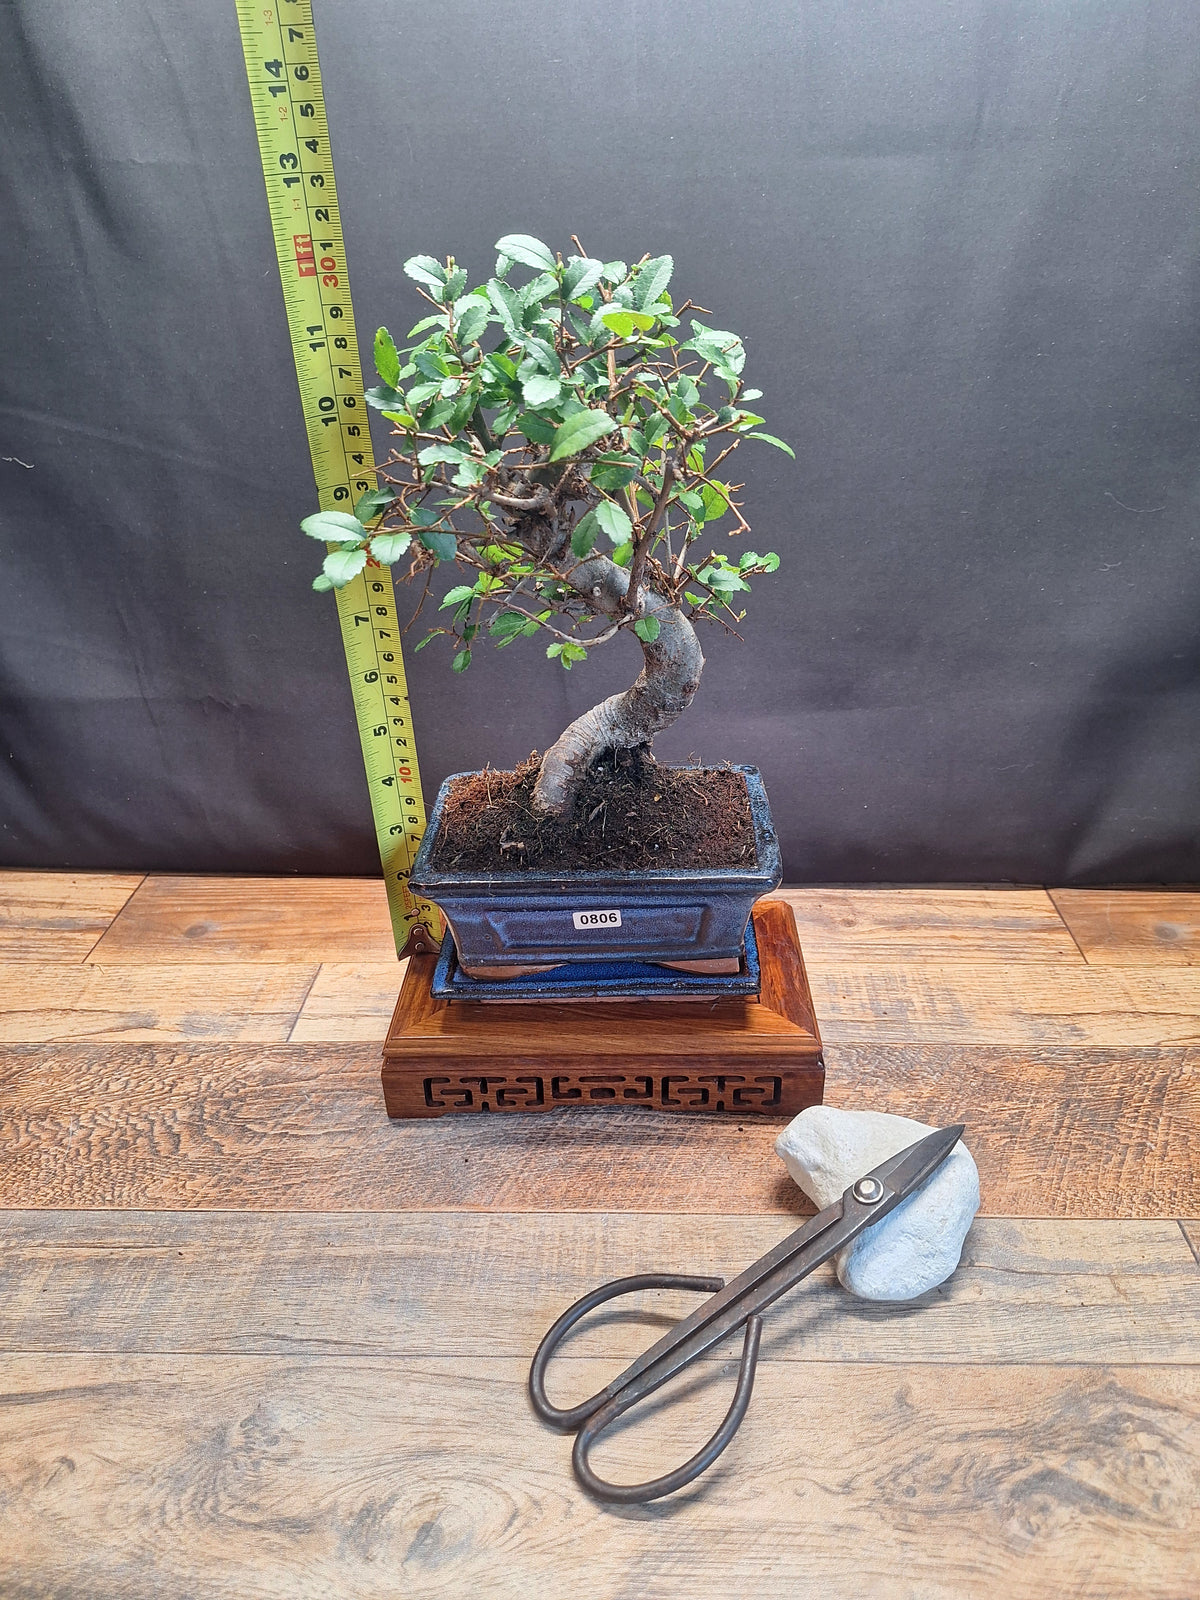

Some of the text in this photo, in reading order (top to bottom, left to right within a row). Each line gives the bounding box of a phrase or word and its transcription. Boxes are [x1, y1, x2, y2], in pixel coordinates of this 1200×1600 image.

[288, 28, 304, 43] 7
[264, 59, 287, 98] 14
[294, 65, 310, 81] 6
[300, 103, 315, 118] 5
[305, 139, 319, 153] 4
[279, 152, 301, 189] 13
[310, 174, 325, 188] 3
[315, 208, 330, 222] 2
[320, 242, 334, 252] 1
[296, 235, 315, 273] 1ft
[320, 256, 339, 289] 30
[330, 306, 344, 319] 9
[306, 325, 326, 353] 11
[334, 336, 348, 350] 8
[339, 367, 352, 379] 7
[343, 396, 357, 409] 6
[318, 396, 338, 428] 10
[348, 425, 361, 437] 5
[352, 453, 365, 465] 4
[356, 481, 369, 492] 3
[333, 486, 350, 501] 9
[372, 582, 385, 593] 9
[376, 606, 389, 617] 8
[354, 615, 370, 627] 7
[380, 630, 392, 640] 7
[383, 652, 395, 662] 6
[364, 671, 379, 684] 6
[387, 675, 398, 685] 5
[390, 696, 402, 706] 4
[393, 718, 404, 727] 3
[373, 725, 388, 737] 5
[396, 738, 407, 747] 2
[398, 766, 413, 784] 10
[381, 776, 395, 787] 4
[405, 797, 416, 806] 9
[408, 816, 419, 825] 8
[389, 825, 403, 836] 3
[397, 870, 411, 881] 2
[421, 904, 431, 912] 3
[580, 912, 618, 925] 0806
